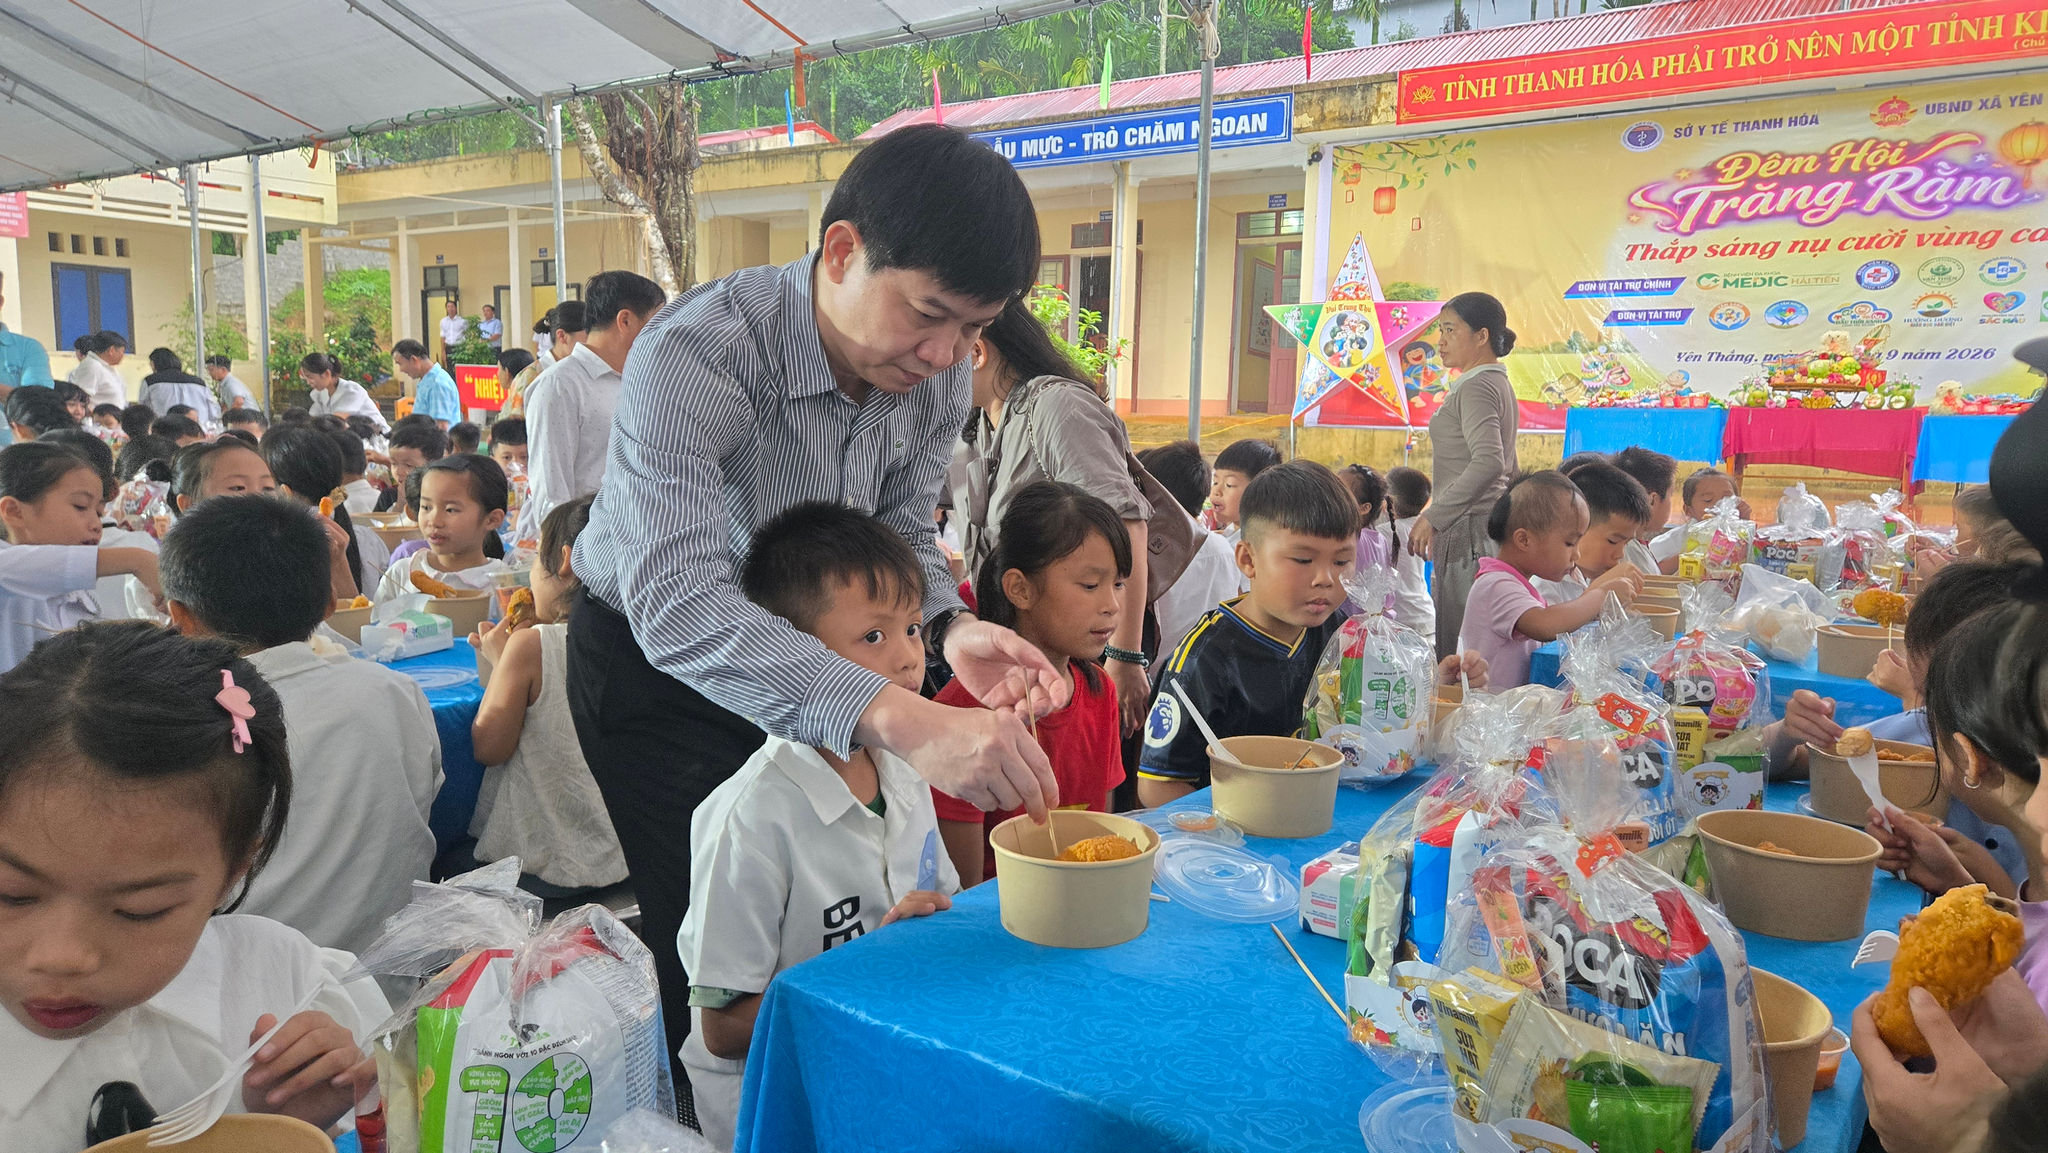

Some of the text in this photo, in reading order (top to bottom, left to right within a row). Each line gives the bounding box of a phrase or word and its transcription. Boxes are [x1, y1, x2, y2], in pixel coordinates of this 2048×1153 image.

[1443, 74, 1497, 102] TỈNH
[1502, 66, 1586, 95] THANH
[1591, 55, 1645, 86] HÓA
[1651, 44, 1714, 79] PHẢI
[1721, 34, 1779, 69] TRỞ
[1785, 31, 1844, 62] NÊN
[1850, 21, 1921, 57] MỘT
[1928, 12, 2007, 46] TỈNH
[1925, 92, 2044, 116] UBND XÃ YÊN
[994, 136, 1016, 159] ẪU
[1022, 135, 1063, 159] MỰC
[1082, 125, 1119, 151] TRÒ
[1124, 121, 1185, 146] CHĂM
[1673, 124, 1694, 140] SỞ
[1698, 123, 1706, 137] Y
[1709, 116, 1728, 136] TẾ
[1732, 117, 1784, 135] THANH
[1787, 112, 1820, 129] HÓA
[1717, 139, 1909, 186] Đêm Hội
[1675, 161, 2019, 235] Trăng Rằm
[1624, 238, 1698, 264] Thắp
[1704, 238, 1781, 261] sáng
[1787, 237, 1831, 256] nụ
[1838, 228, 1908, 252] cười
[1914, 225, 2001, 250] vùng
[1722, 275, 1789, 289] MEDIC
[1676, 352, 1701, 363] Yên
[1886, 349, 1897, 361] 9
[1901, 348, 1941, 361] năm
[1945, 348, 1997, 360] 2026
